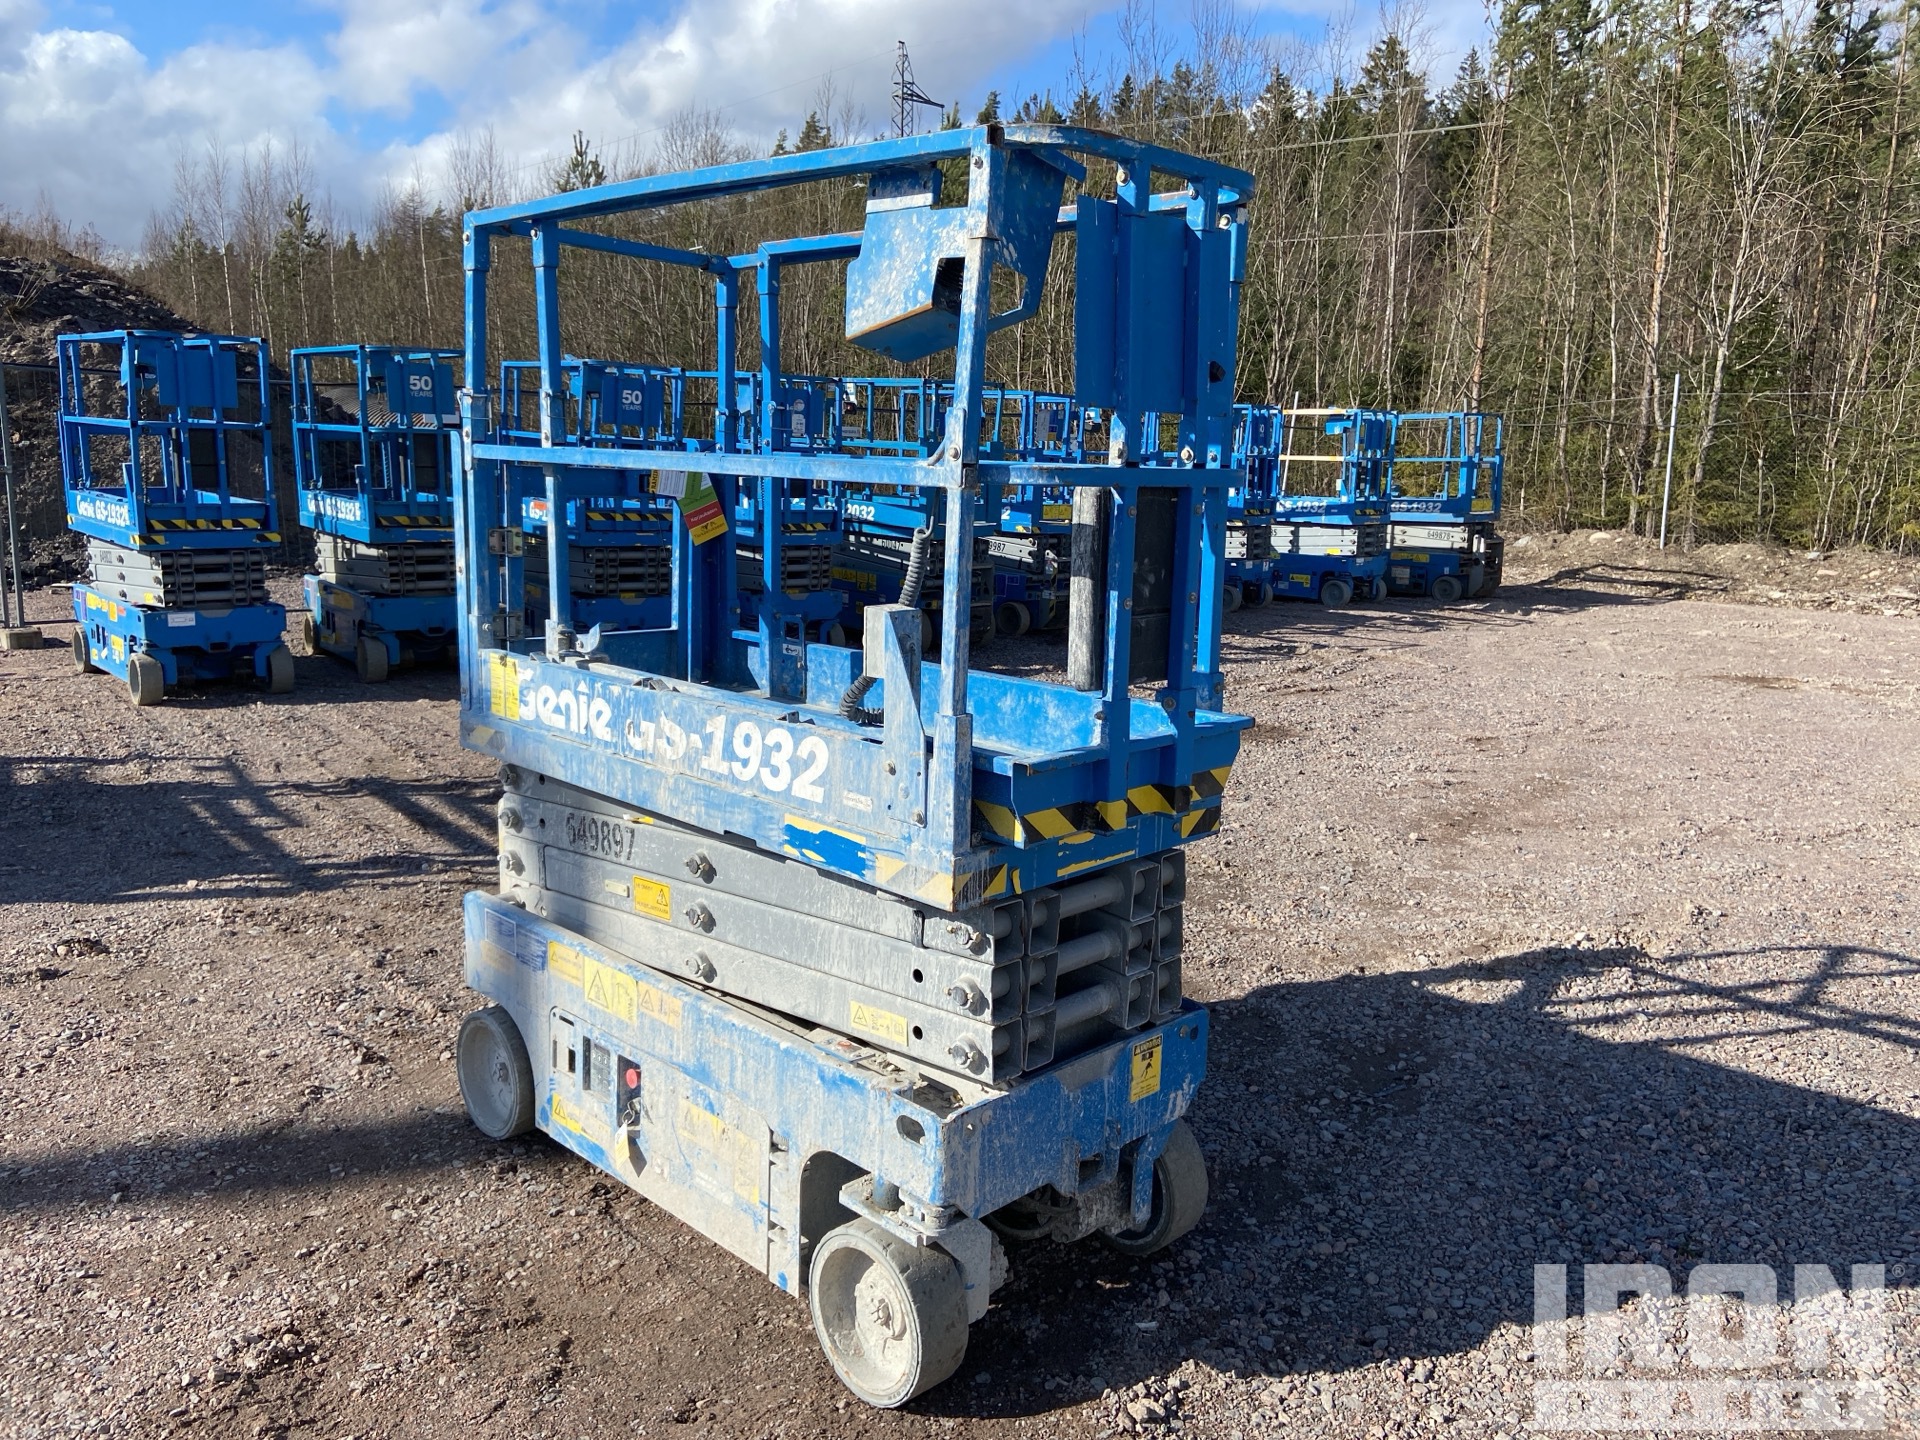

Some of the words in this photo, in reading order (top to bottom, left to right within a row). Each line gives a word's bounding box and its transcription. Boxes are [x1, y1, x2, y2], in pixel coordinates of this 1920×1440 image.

[409, 375, 433, 391] 50
[410, 390, 434, 398] YEARS
[622, 389, 643, 405] 50
[1390, 501, 1442, 513] GS-1932
